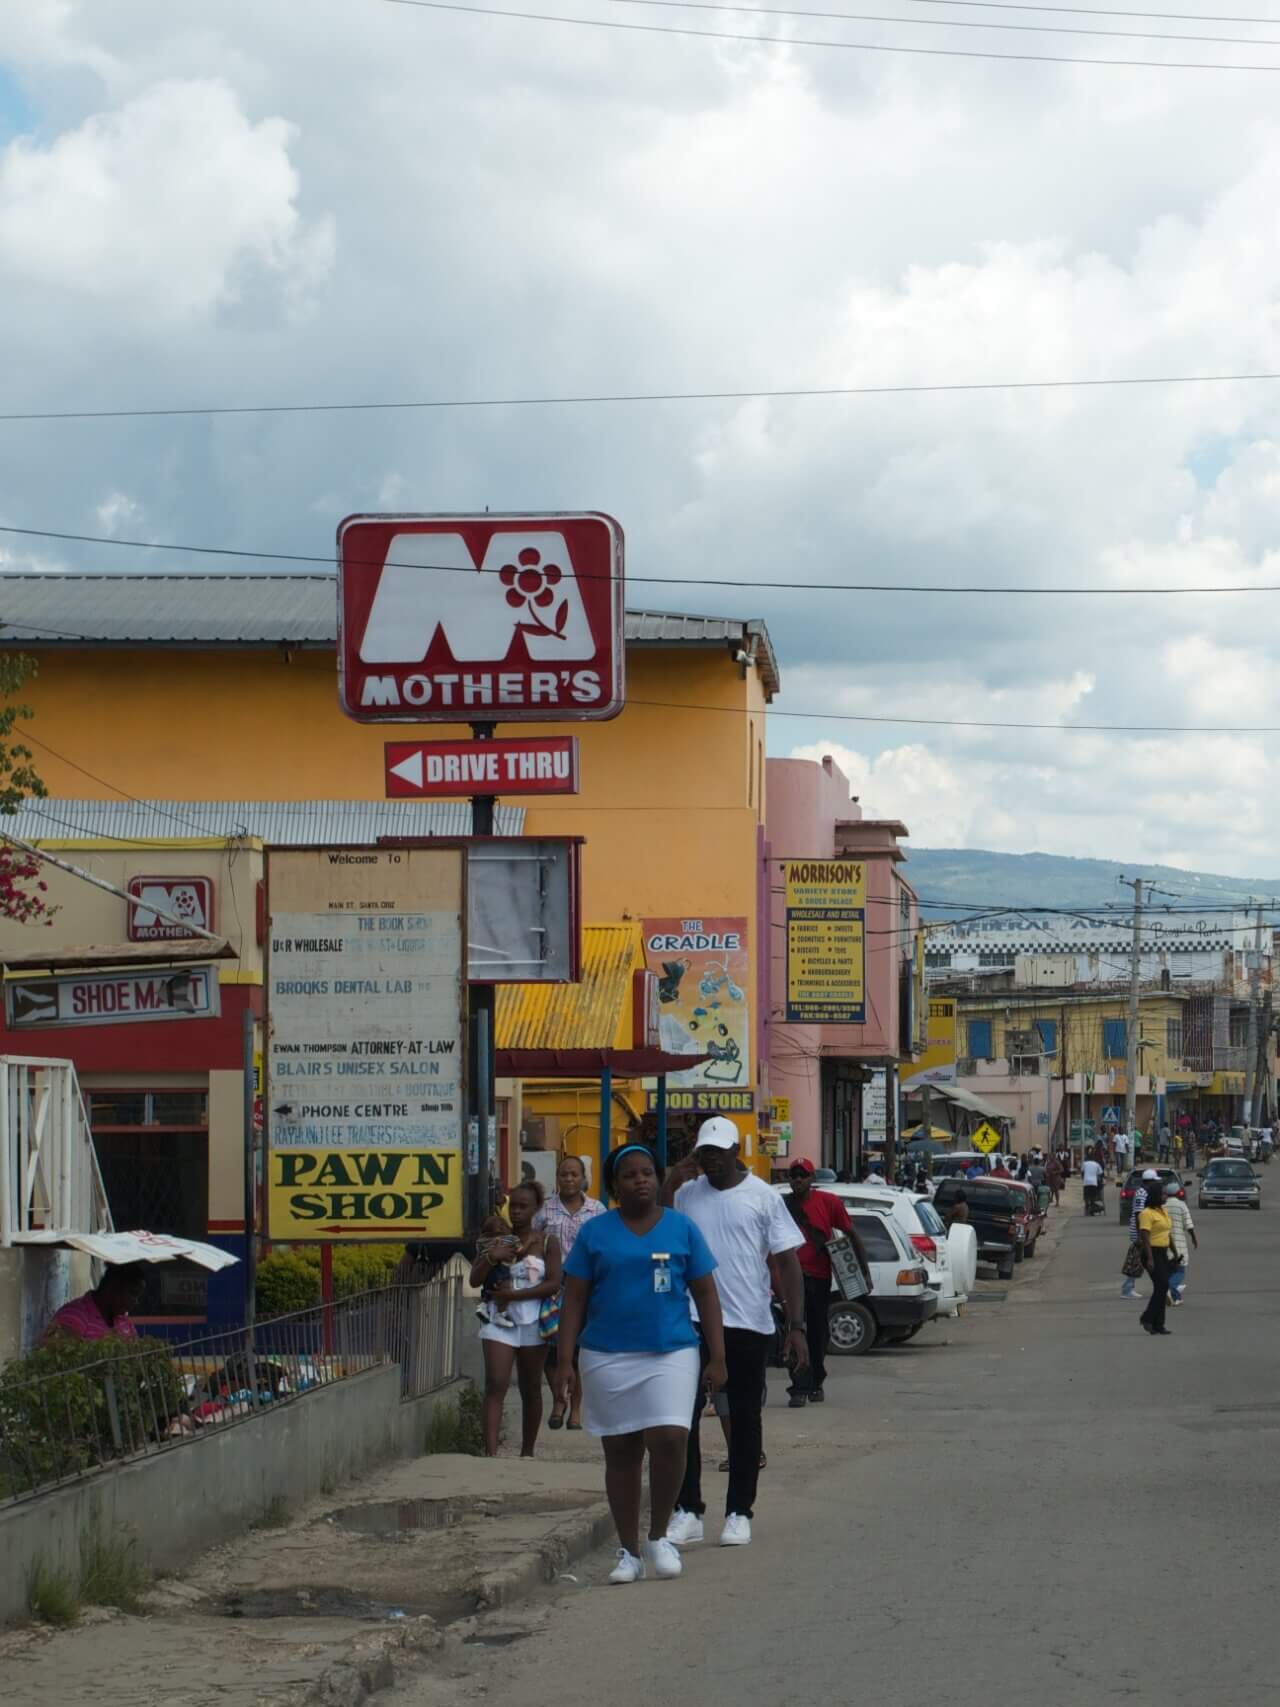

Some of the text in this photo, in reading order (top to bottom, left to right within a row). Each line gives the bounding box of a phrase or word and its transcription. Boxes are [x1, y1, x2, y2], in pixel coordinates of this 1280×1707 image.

[361, 670, 601, 706] MOTHER'S
[427, 751, 570, 783] DRIVE THRU
[328, 854, 401, 865] Welcome To
[789, 864, 862, 883] MORRISON'S
[329, 901, 344, 909] MAIN
[358, 917, 375, 931] THE
[379, 917, 404, 931] BOOK
[681, 920, 703, 932] THE
[137, 927, 193, 937] MOTHER
[295, 938, 343, 952] WHOLESALE
[650, 935, 739, 950] CRADLE
[276, 981, 328, 994] BROOKS
[334, 981, 380, 993] DENTAL
[386, 981, 412, 993] LAB
[73, 977, 203, 1014] SHOE MAT
[273, 1040, 455, 1054] EWAN THOMPSON ATTORNEY-AT-LAW
[337, 1062, 385, 1074] UNISEX
[390, 1062, 439, 1074] SALON
[698, 1091, 751, 1109] STORE
[302, 1105, 349, 1117] PHONE
[355, 1104, 408, 1117] CENTRE
[275, 1154, 455, 1187] PAWN
[290, 1193, 444, 1220] SHOP
